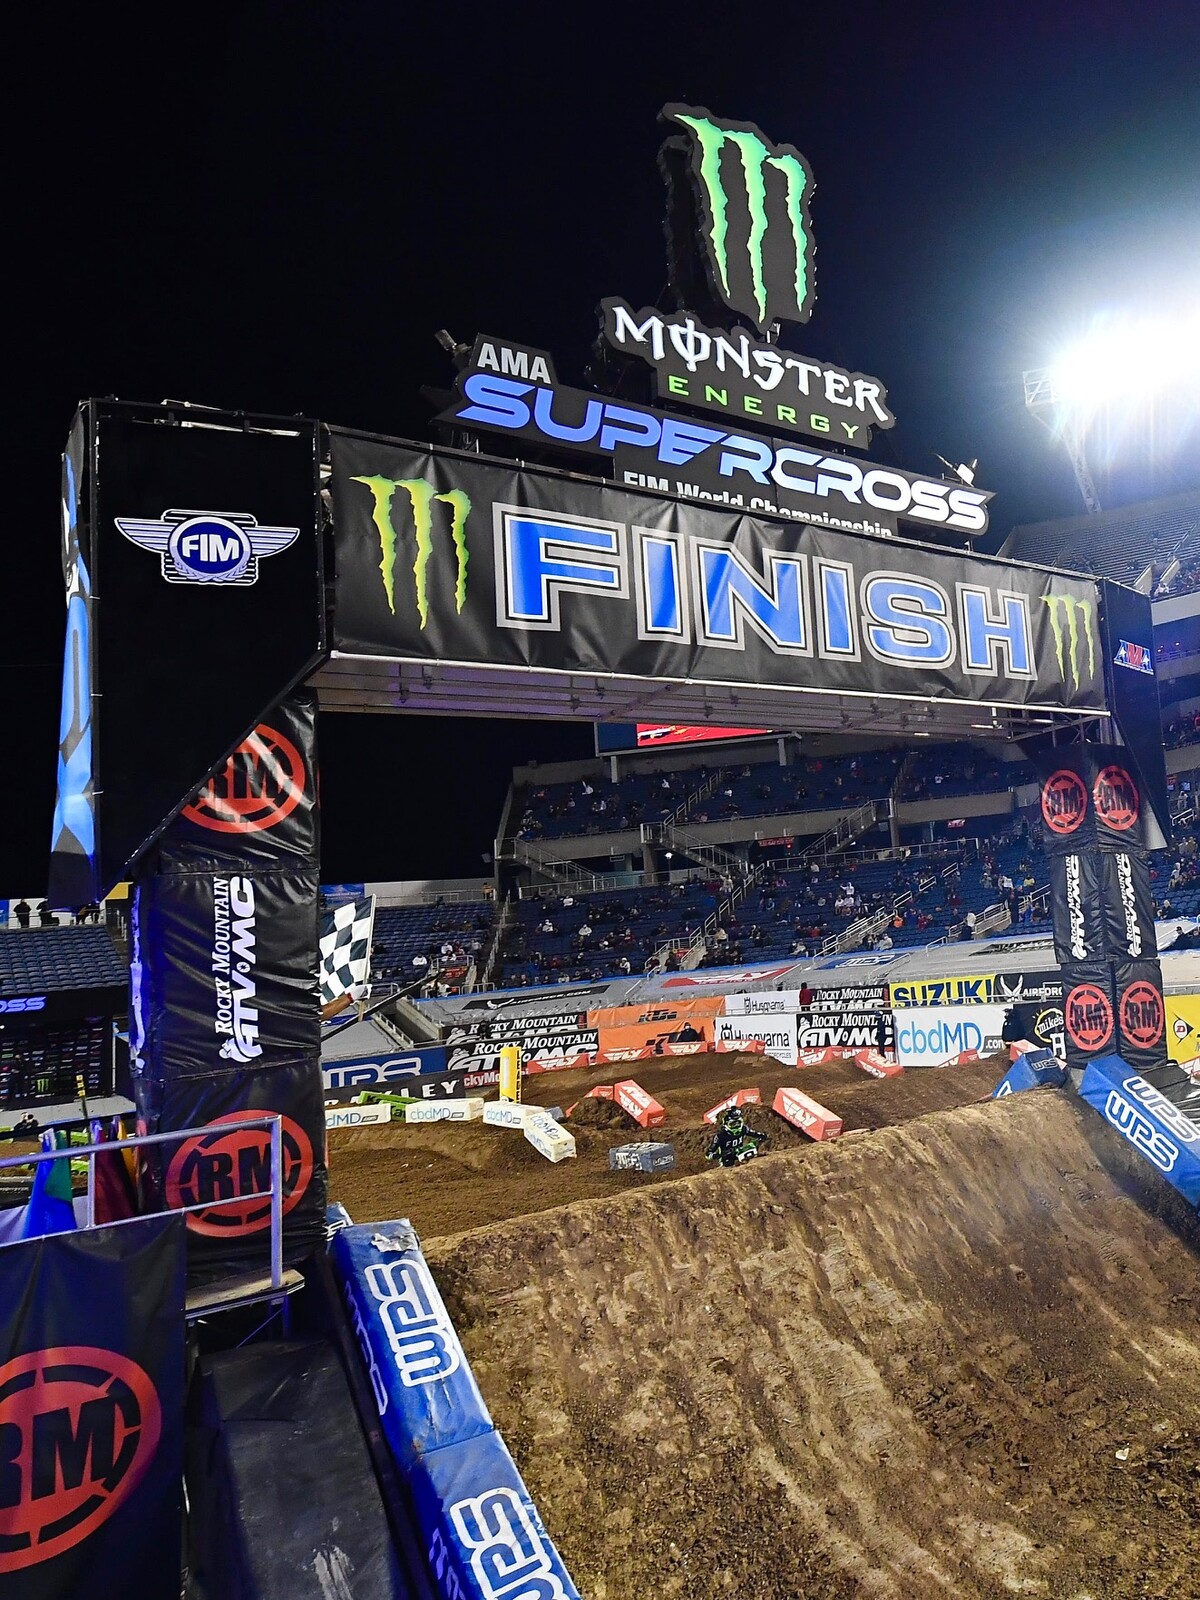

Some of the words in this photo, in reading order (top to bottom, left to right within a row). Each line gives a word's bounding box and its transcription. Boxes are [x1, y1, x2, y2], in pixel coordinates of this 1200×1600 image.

[478, 343, 552, 385] AMA
[612, 306, 896, 424] MONSTER
[668, 375, 859, 440] ENERGY
[455, 373, 990, 533] SUPERCROSS
[181, 534, 240, 563] FIM
[492, 502, 1038, 681] FINISH
[1113, 639, 1154, 672] AMA
[212, 876, 231, 975] MOUNTAIN
[214, 976, 235, 1036] ROCKY
[841, 987, 884, 999] MOUNTAIN
[893, 978, 992, 1008] SUZUKI
[511, 1014, 578, 1031] MOUNTAIN
[812, 1015, 840, 1028] ROCKY
[1037, 1011, 1064, 1034] mike's
[1073, 1002, 1104, 1031] RM
[1125, 999, 1157, 1030] RM
[522, 1031, 598, 1049] MOUNTAIN
[899, 1019, 982, 1054] cbdMD
[1122, 1075, 1200, 1143] WPS
[726, 1137, 743, 1149] FOX
[1104, 1089, 1179, 1173] WPS
[199, 1142, 278, 1201] RM
[364, 1258, 461, 1388] WPS
[450, 1487, 571, 1600] PS
